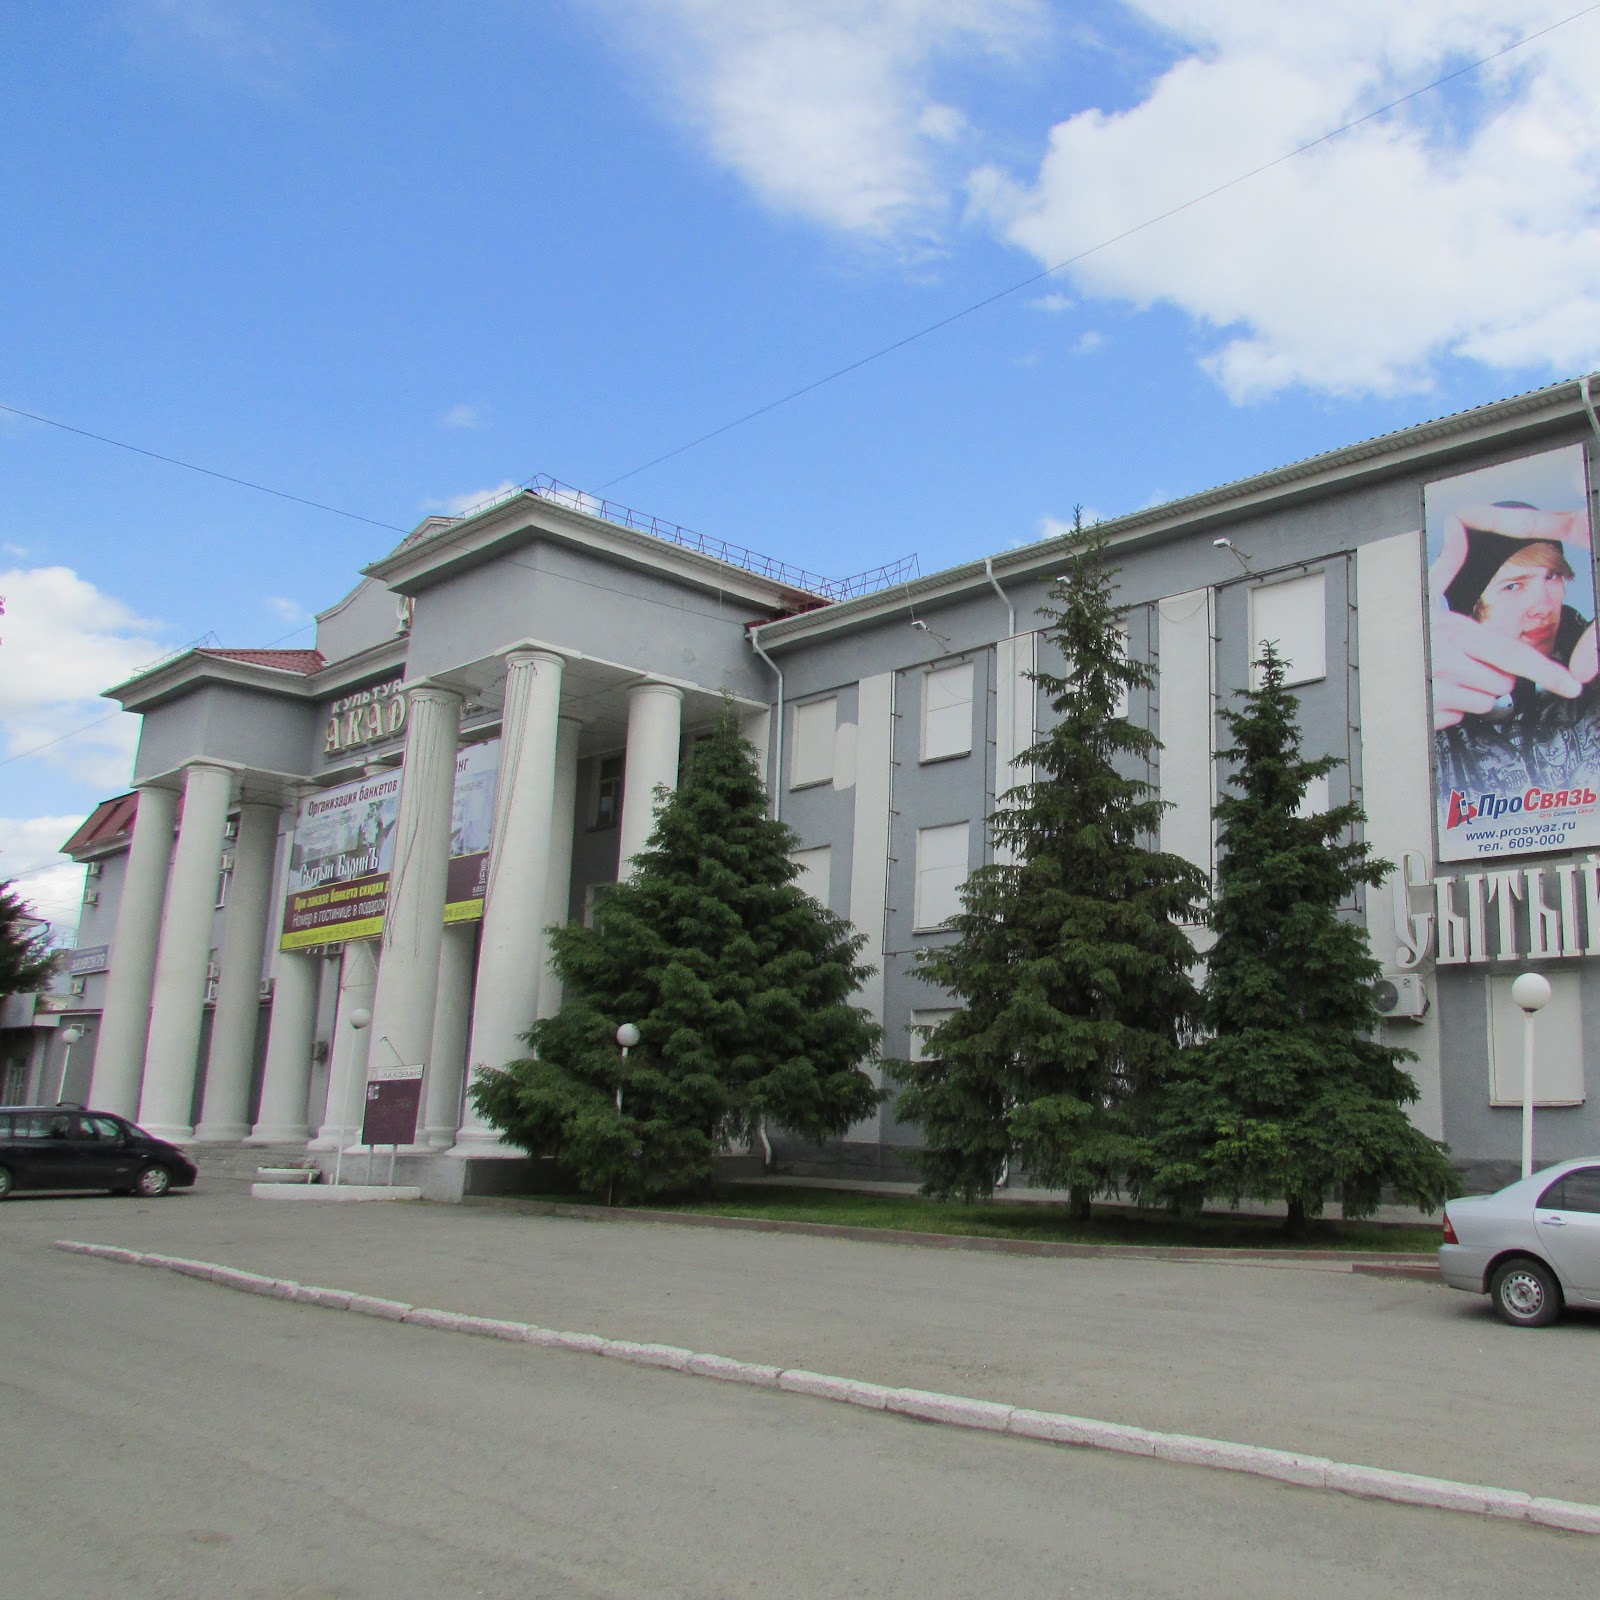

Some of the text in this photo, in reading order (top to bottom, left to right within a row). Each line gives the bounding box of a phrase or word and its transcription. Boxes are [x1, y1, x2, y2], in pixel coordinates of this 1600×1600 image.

[331, 679, 403, 714] КУЛЬТУР
[308, 779, 398, 818] Организация банкетов
[1466, 821, 1576, 841] www.prosvyaz.ru
[1477, 833, 1565, 852] тел. 609-000
[330, 887, 359, 903] банкета
[318, 905, 353, 923] гостинице
[352, 904, 358, 917] в
